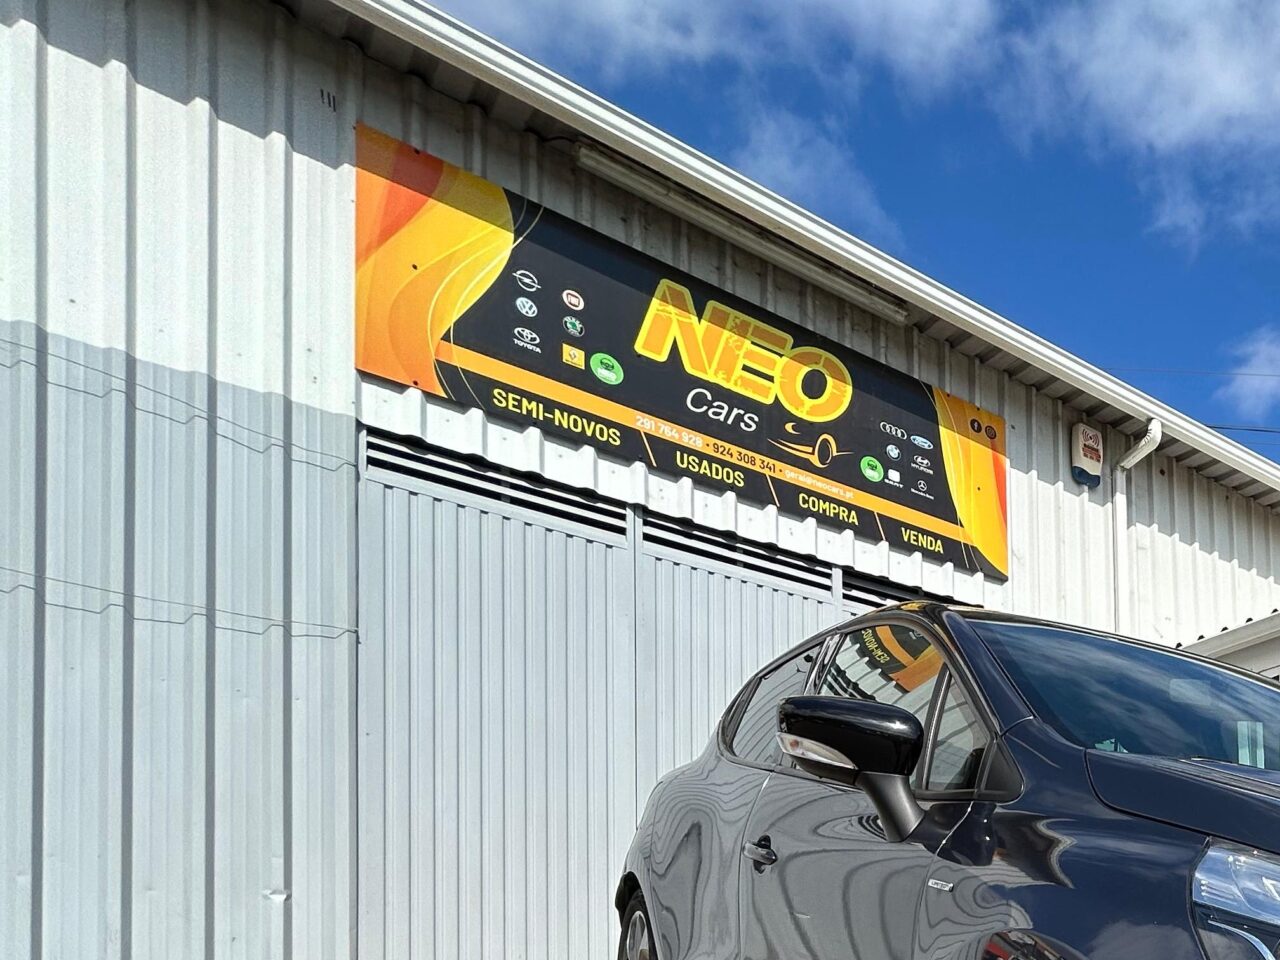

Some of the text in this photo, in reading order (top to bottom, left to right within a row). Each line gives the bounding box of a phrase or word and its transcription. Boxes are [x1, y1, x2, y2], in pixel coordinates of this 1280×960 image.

[513, 338, 542, 354] TOYOTA
[634, 278, 853, 422] NEO
[493, 388, 621, 446] SEMI-NOVOS
[686, 388, 759, 432] Cars
[635, 415, 655, 430] 291
[658, 422, 679, 440] 764
[682, 432, 703, 448] 928
[712, 442, 734, 459] 924
[737, 450, 756, 466] 308
[759, 460, 776, 474] 341
[676, 450, 745, 487] USADOS
[798, 493, 859, 526] COMPRA
[901, 527, 944, 554] VENDA
